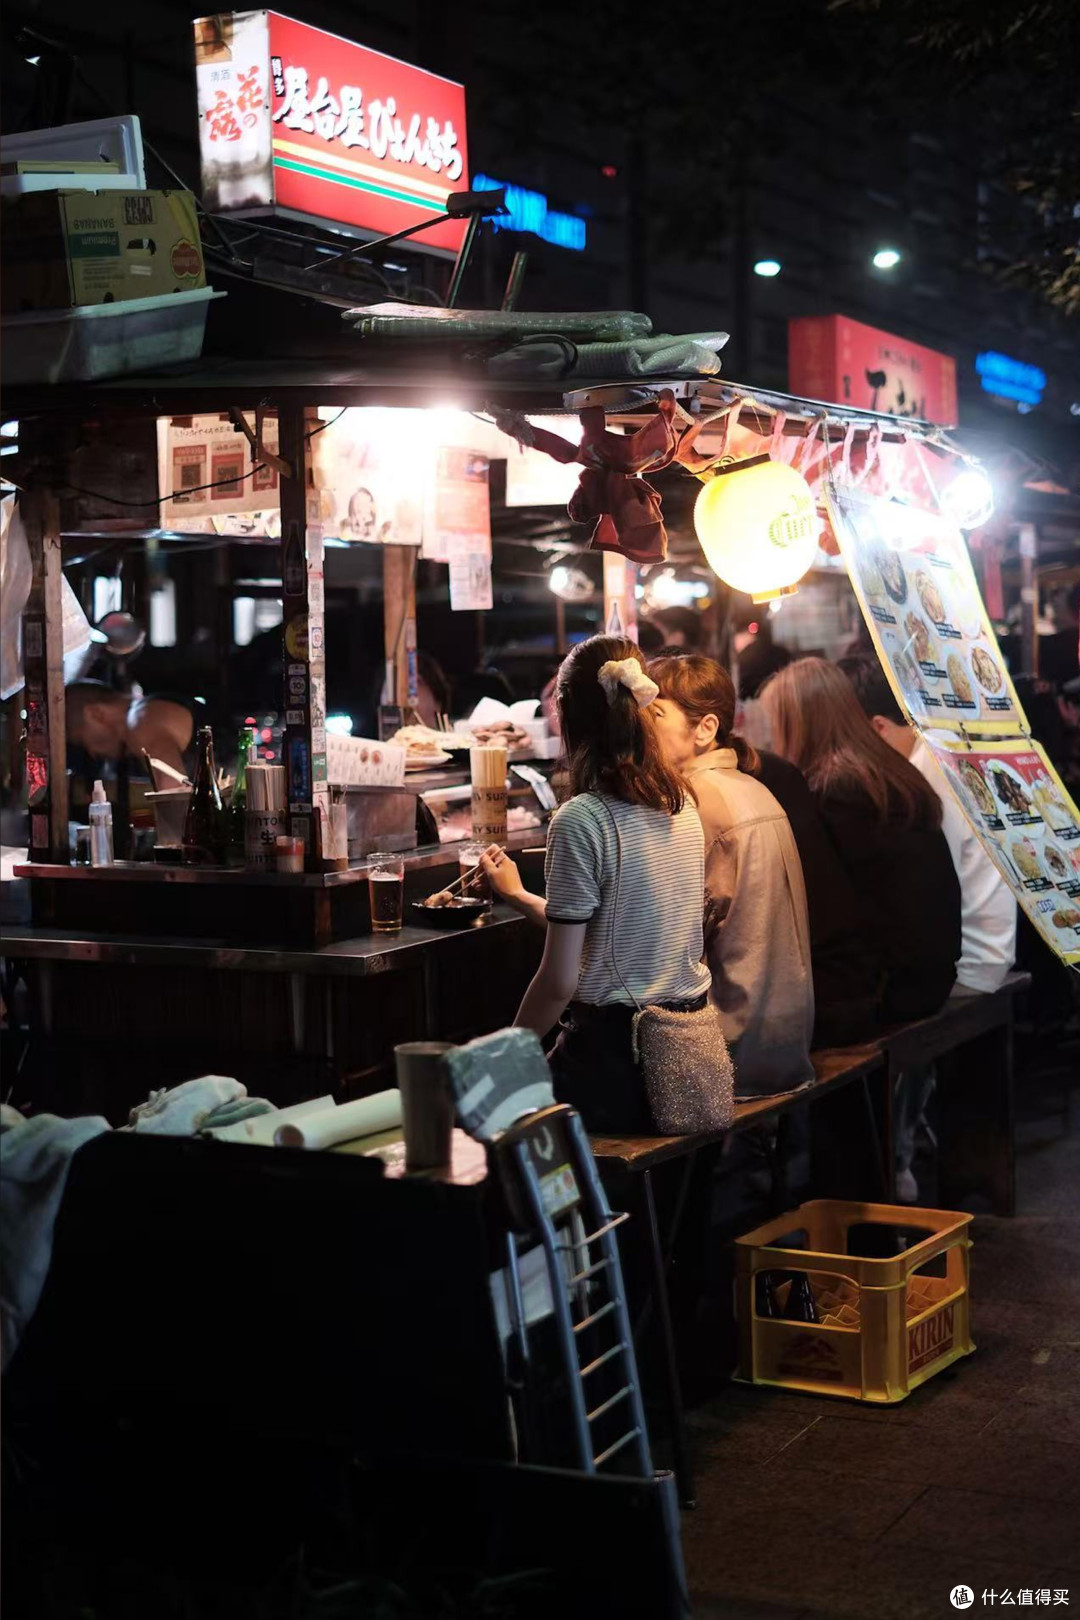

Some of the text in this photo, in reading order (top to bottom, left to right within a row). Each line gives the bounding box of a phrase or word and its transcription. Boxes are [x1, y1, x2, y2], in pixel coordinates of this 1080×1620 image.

[72, 217, 115, 230] BANANAS
[80, 235, 118, 247] Premium
[261, 829, 275, 846] 生
[908, 1304, 954, 1363] KIRIN
